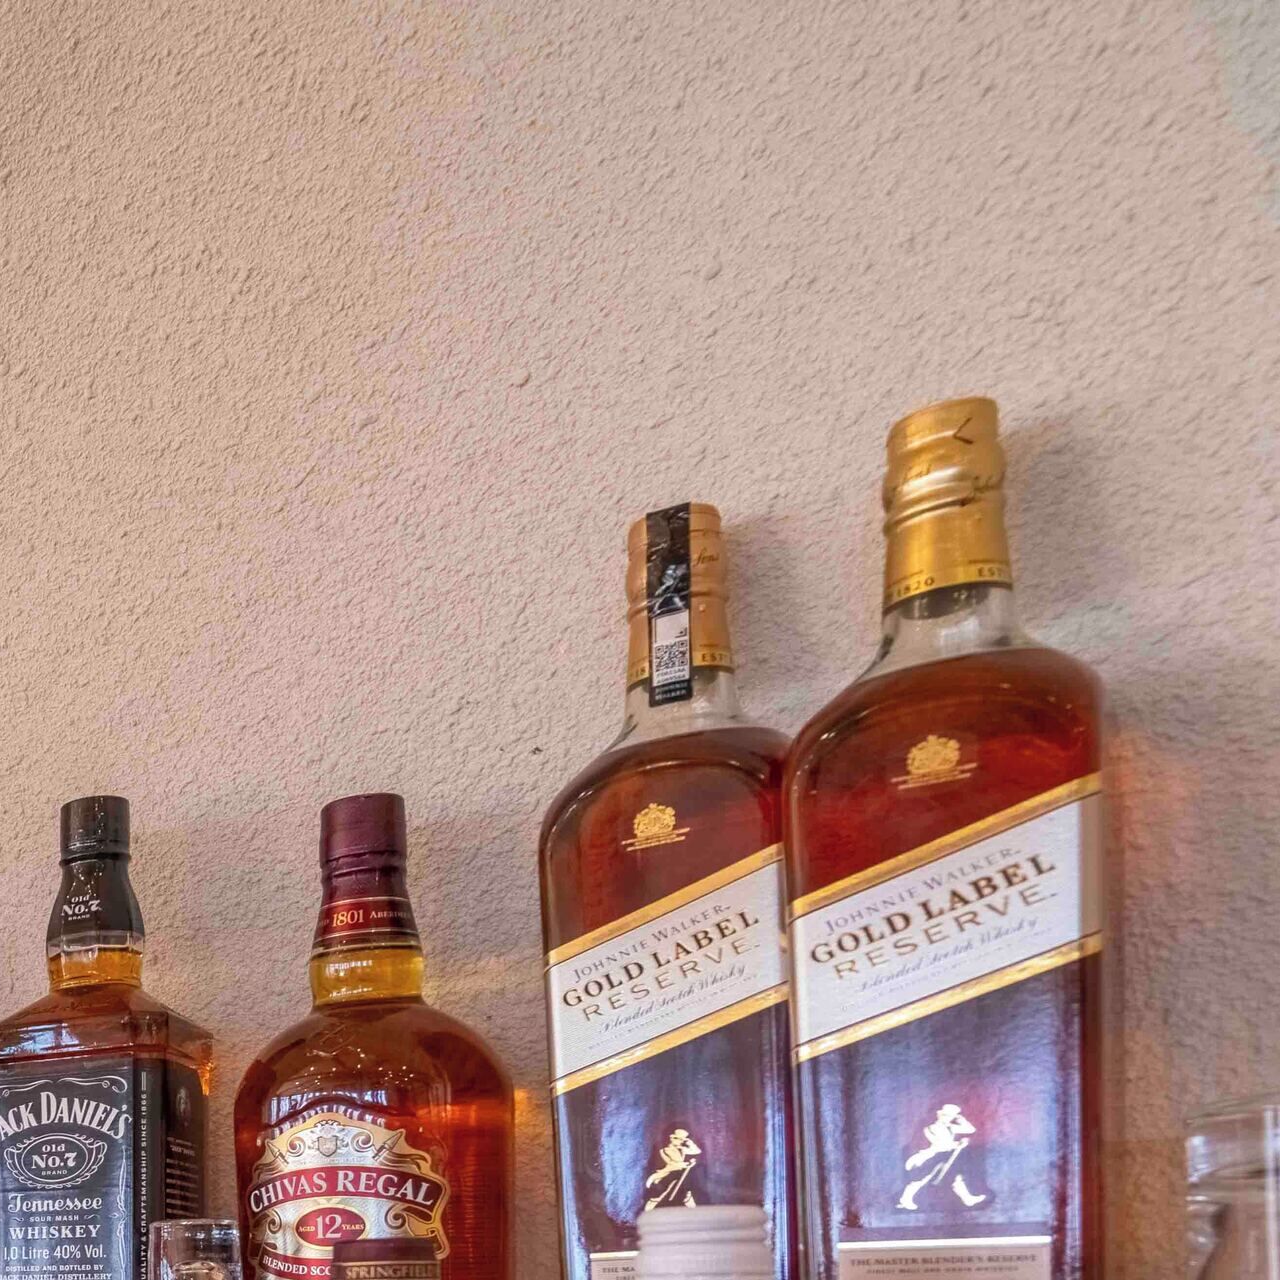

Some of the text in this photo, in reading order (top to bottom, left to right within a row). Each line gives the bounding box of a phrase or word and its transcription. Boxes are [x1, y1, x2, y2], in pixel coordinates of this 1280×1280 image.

[71, 894, 91, 903] Old
[825, 847, 1014, 936] JOHNNIE WALKER
[61, 900, 101, 916] No.7
[332, 909, 365, 927] 1801
[810, 852, 1056, 964] GOLD LABEL
[833, 884, 1051, 980] RESERVE
[574, 903, 724, 984] JOHNNIE WALKER
[563, 910, 759, 1007] GOLD LABEL
[582, 937, 752, 1022] RESERVE
[599, 964, 746, 1034] Blended Scotch Whisky
[40, 1091, 133, 1140] DANIEL'S
[42, 1143, 66, 1153] Old
[31, 1151, 78, 1169] No.7
[250, 1170, 435, 1213] CHIVAS REGAL
[7, 1193, 103, 1213] Tennessee
[8, 1224, 102, 1240] WHISKEY
[298, 1213, 365, 1240] AGED 12 YEARS
[22, 1246, 50, 1260] Litre
[53, 1244, 82, 1260] 40%
[84, 1243, 107, 1259] Vol.
[851, 1258, 870, 1266] THE
[874, 1256, 920, 1266] MASTER
[59, 1264, 92, 1272] BOTTLED
[263, 1255, 308, 1275] BLENDED
[57, 1272, 113, 1280] DISTILLERY
